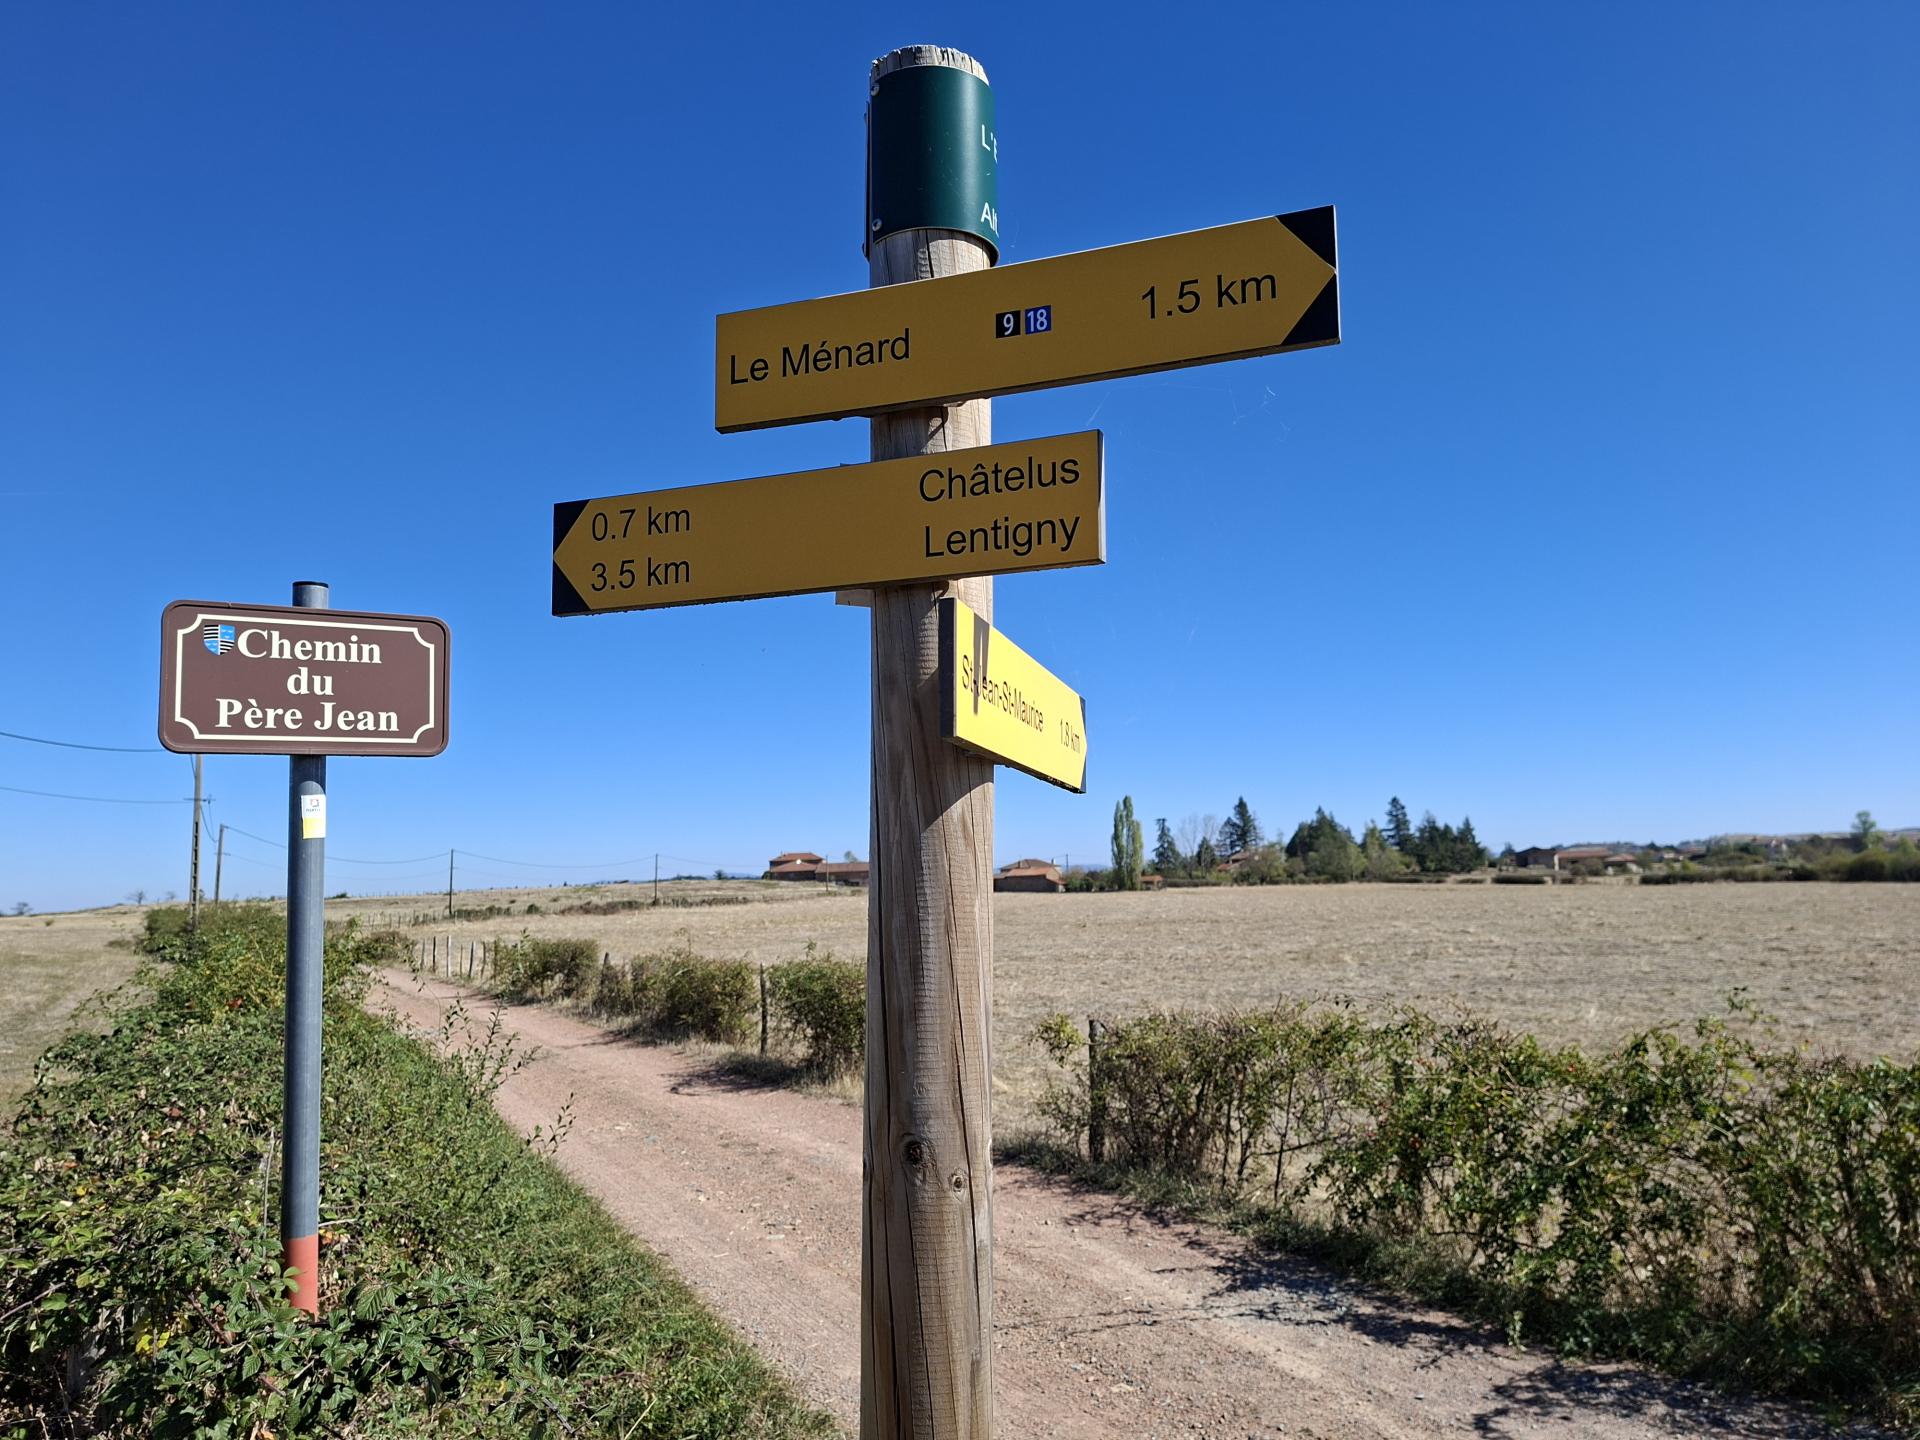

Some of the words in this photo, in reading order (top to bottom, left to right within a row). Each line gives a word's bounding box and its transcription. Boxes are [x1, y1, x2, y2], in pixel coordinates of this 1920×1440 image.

[1141, 278, 1201, 320] 1.5
[1216, 273, 1277, 308] km
[1003, 313, 1014, 336] 9
[1027, 308, 1048, 332] 18
[730, 354, 769, 385] Le
[782, 327, 910, 378] Ménard
[919, 455, 1080, 502] Châtelus
[592, 508, 636, 541] 0.7
[647, 506, 690, 535] km
[925, 515, 1080, 557] Lentigny
[591, 559, 636, 592] 3.5
[647, 556, 690, 587] km
[236, 628, 383, 665] Chemin
[286, 667, 335, 696] du
[961, 654, 1044, 733] St-Jean-St-Maurice
[215, 698, 303, 730] Père
[313, 702, 400, 732] Jean
